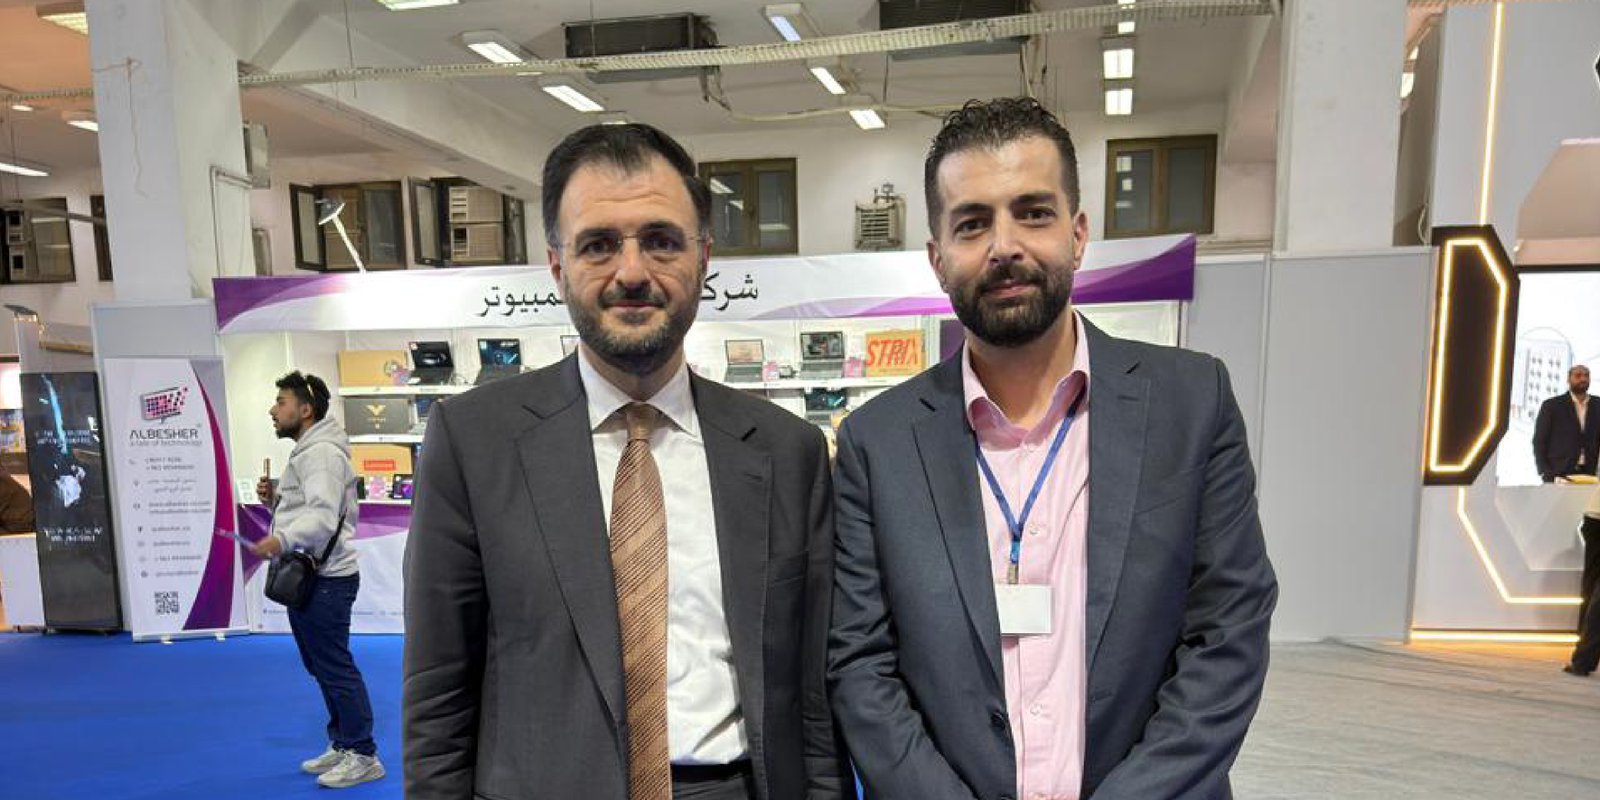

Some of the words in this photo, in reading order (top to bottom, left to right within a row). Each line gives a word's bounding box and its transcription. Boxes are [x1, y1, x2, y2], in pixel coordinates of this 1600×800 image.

[477, 286, 566, 317] مبيوتر
[701, 271, 759, 311] شرك
[864, 338, 920, 368] STRIX
[129, 428, 199, 440] ALBESHER
